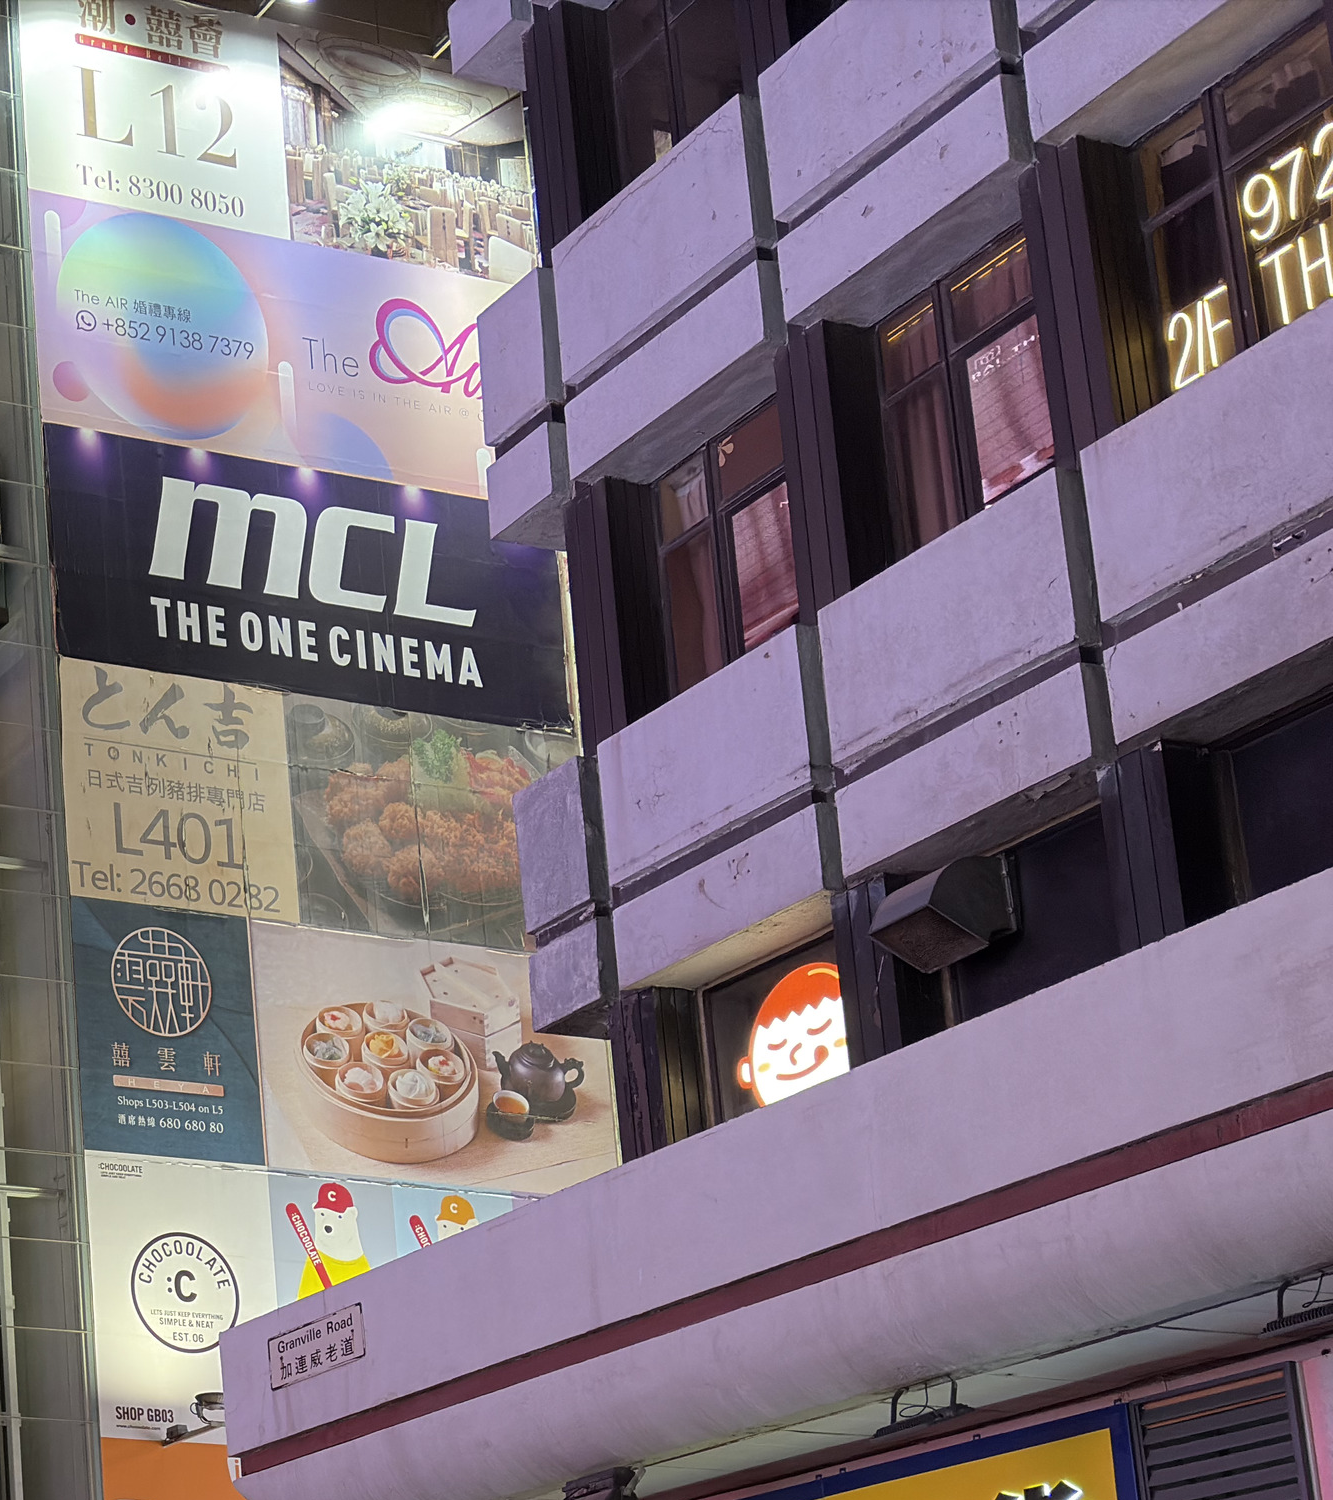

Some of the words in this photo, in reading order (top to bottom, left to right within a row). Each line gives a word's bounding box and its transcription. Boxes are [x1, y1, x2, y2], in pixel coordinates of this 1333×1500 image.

[76, 163, 121, 193] Tel:
[128, 174, 183, 206] 8300
[190, 187, 244, 218] 8050
[74, 289, 101, 306] The
[105, 295, 128, 311] AIR
[102, 316, 151, 342] +852
[155, 325, 203, 351] 9138
[208, 334, 255, 361] 7379
[302, 336, 359, 378] The
[1167, 283, 1232, 391] 2F
[308, 380, 345, 396] LOVE
[352, 389, 366, 400] IS
[373, 393, 387, 404] IN
[395, 396, 421, 411] THE
[429, 404, 452, 416] AIR
[150, 596, 227, 648] THE
[239, 611, 319, 663] ONE
[329, 626, 484, 688] CINEMA
[82, 665, 253, 750] とん吉
[84, 742, 259, 782] TONKICHI
[113, 801, 245, 871] L401
[72, 860, 122, 893] Tel:
[130, 867, 201, 902] 2668
[117, 1095, 144, 1109] Shops
[146, 1098, 196, 1113] L503-L504
[198, 1105, 210, 1114] on
[212, 1104, 224, 1115] L5
[128, 1078, 210, 1094] HEYA
[159, 1117, 181, 1130] 680
[184, 1119, 206, 1132] 680
[209, 1122, 224, 1134] 80
[328, 1190, 337, 1202] C
[450, 1203, 459, 1214] C
[138, 1239, 231, 1290] CHOCOOLATE
[159, 1317, 186, 1328] SIMPLE
[196, 1320, 214, 1330] NEAT
[277, 1329, 322, 1354] Granville
[326, 1313, 353, 1336] Road
[279, 1337, 355, 1381] 加連威老道
[115, 1405, 144, 1421] SHOP
[147, 1408, 174, 1424] GB03
